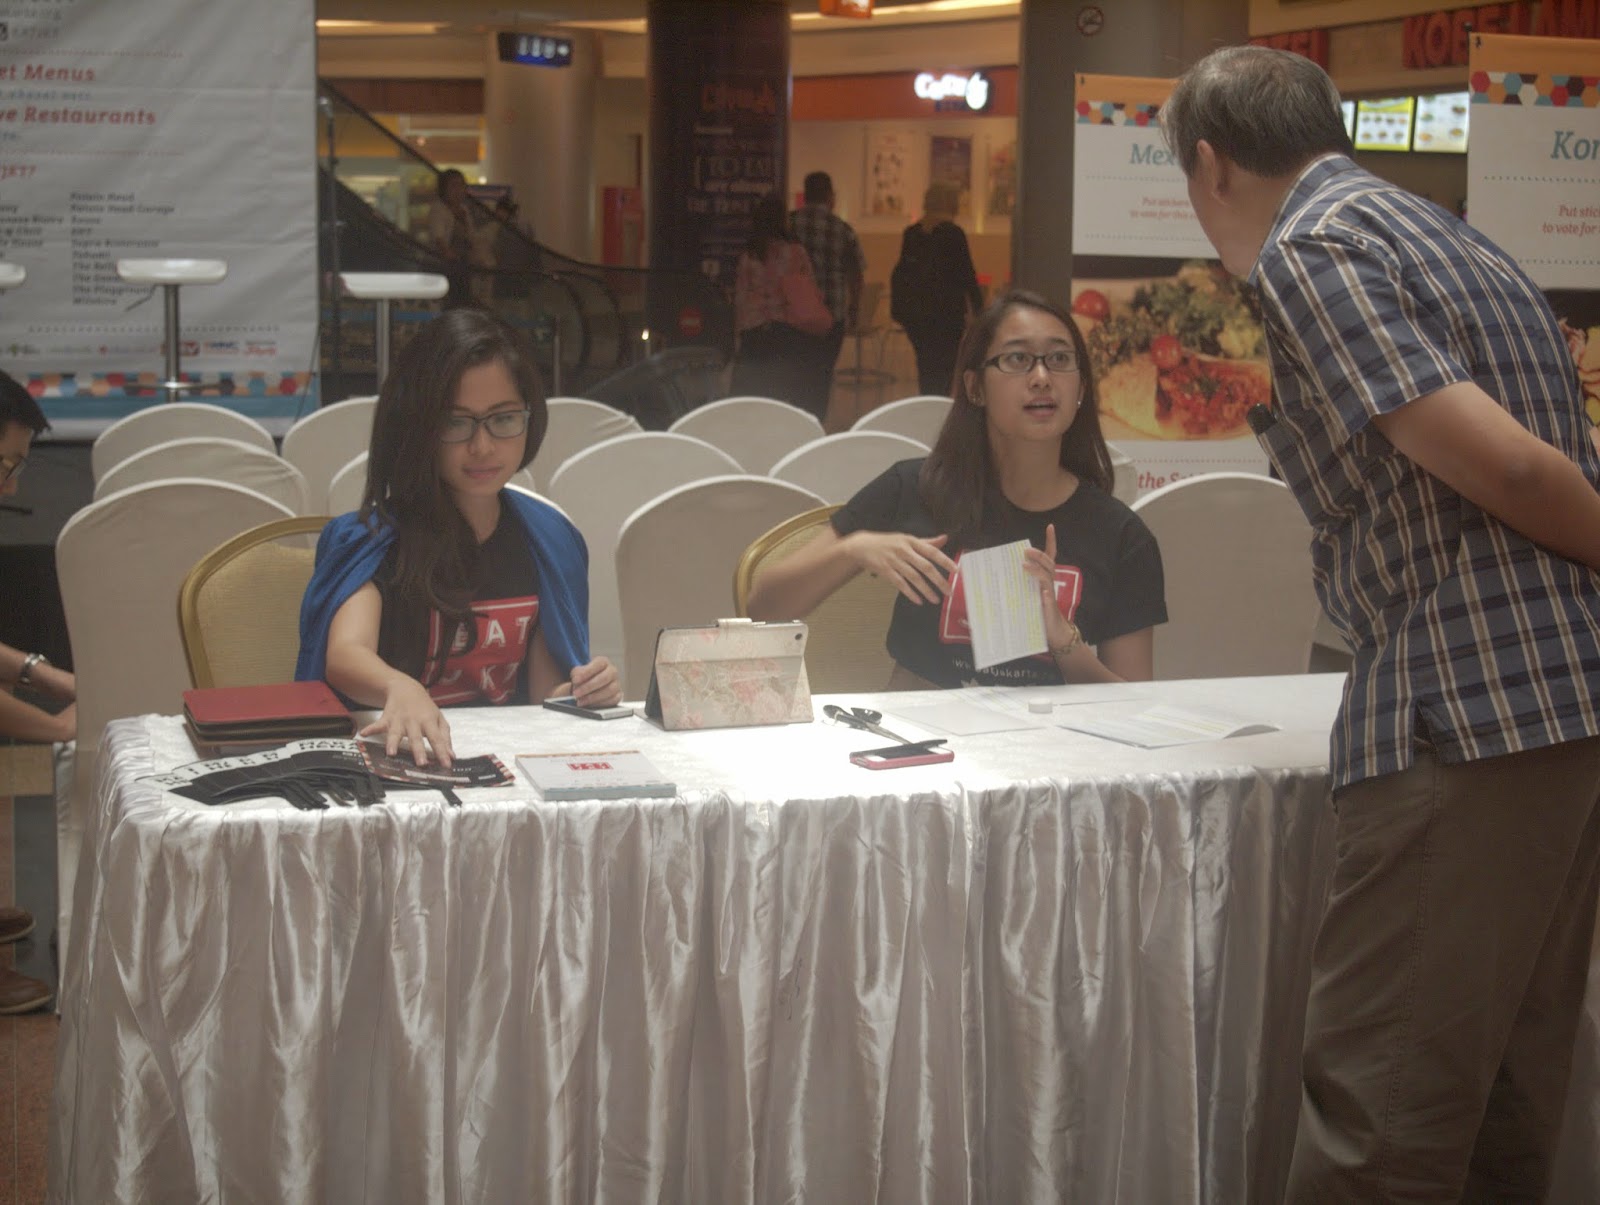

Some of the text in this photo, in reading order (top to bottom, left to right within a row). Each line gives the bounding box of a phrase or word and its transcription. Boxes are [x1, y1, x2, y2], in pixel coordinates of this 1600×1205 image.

[24, 64, 96, 81] Menus
[24, 106, 157, 125] Restaurants
[1129, 142, 1178, 166] Mex
[1558, 204, 1577, 217] Put
[1542, 222, 1554, 234] to
[1556, 223, 1579, 235] vote
[1137, 471, 1166, 489] the
